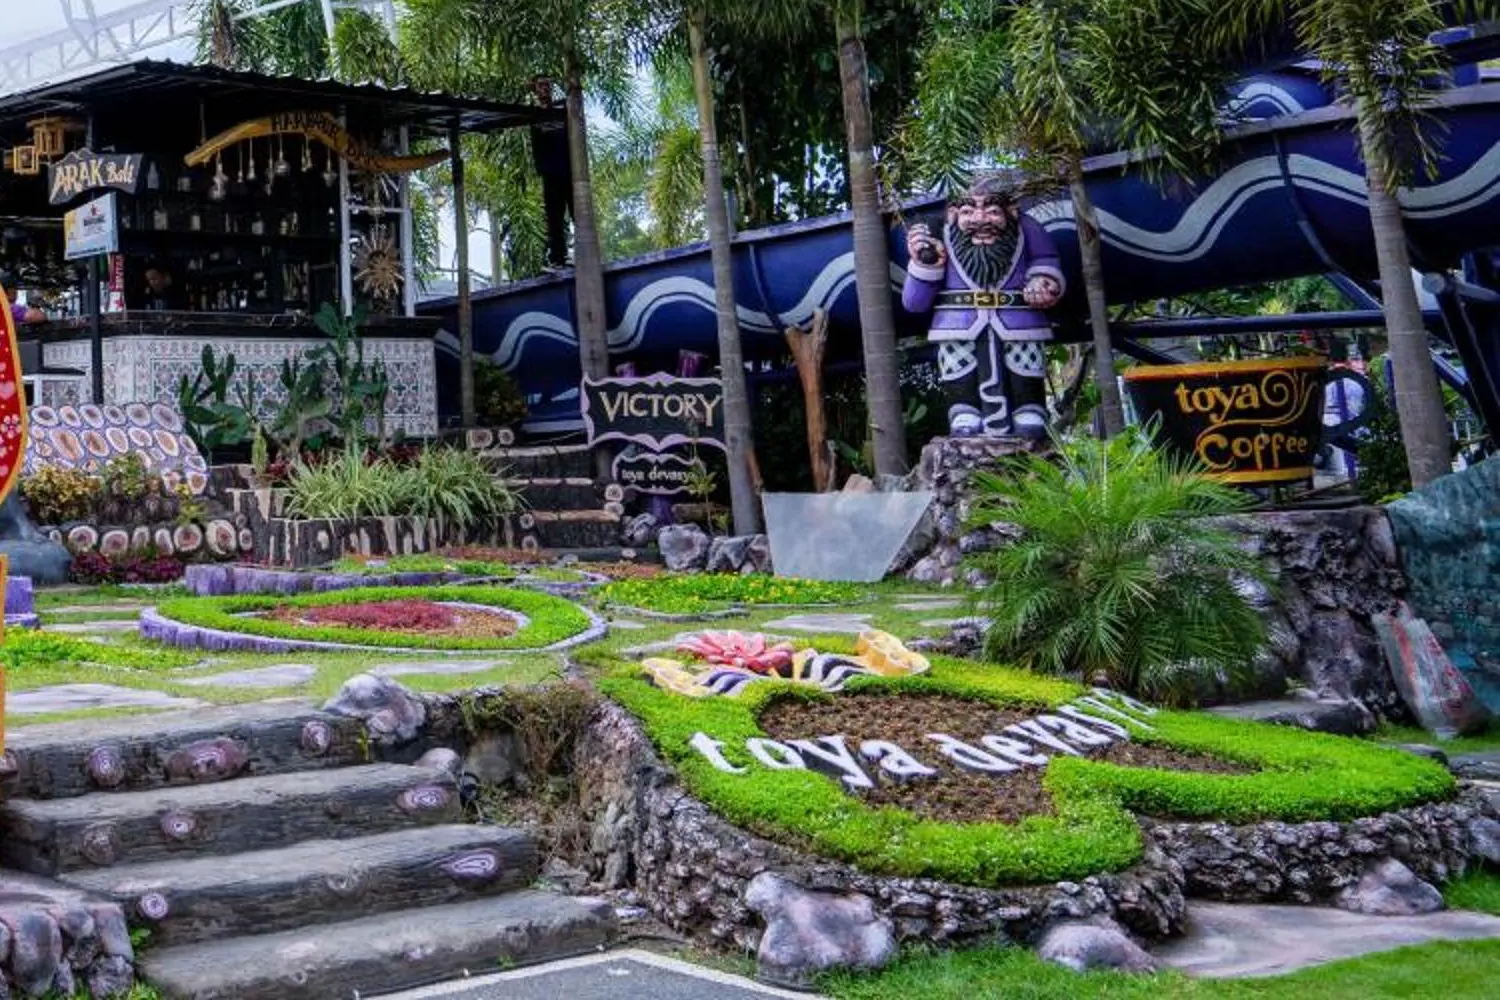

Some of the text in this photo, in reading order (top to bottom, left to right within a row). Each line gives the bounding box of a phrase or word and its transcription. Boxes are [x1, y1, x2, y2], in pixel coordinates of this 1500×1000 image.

[50, 158, 107, 203] ARAK
[598, 391, 722, 427] VICTORY
[1175, 380, 1261, 424] toya
[1198, 432, 1309, 471] Coffee
[689, 686, 1160, 794] toya devasya
